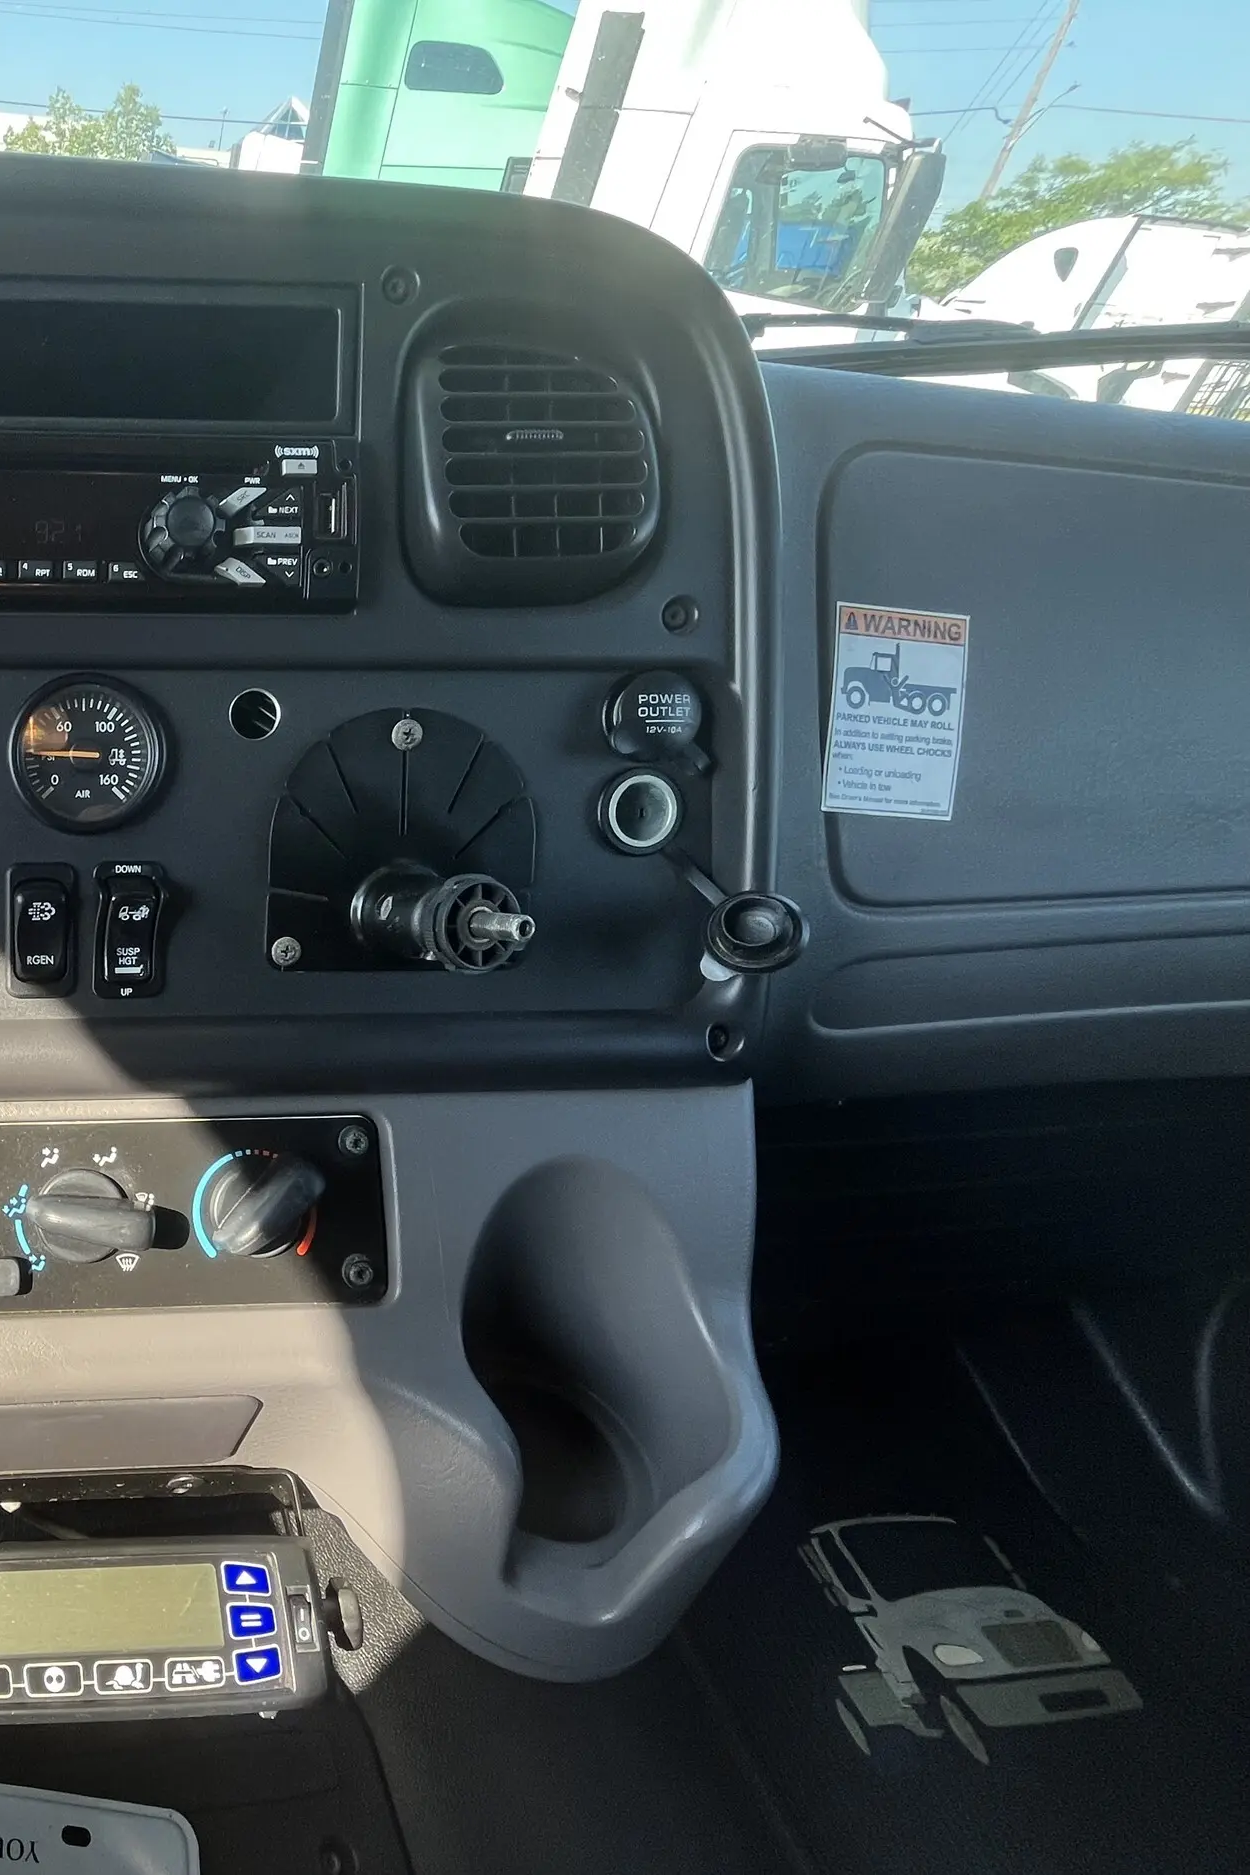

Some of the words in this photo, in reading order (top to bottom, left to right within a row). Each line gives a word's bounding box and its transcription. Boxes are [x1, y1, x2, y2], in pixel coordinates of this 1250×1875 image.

[160, 475, 182, 483] MENU
[188, 475, 199, 483] OK
[244, 477, 261, 485] PWR
[279, 506, 299, 514] NEXT
[256, 531, 277, 539] SCAN
[277, 557, 298, 566] PREV
[35, 568, 51, 577] RPT
[76, 568, 96, 577] RDM
[122, 570, 139, 579] ESC
[235, 566, 251, 580] DISP
[863, 612, 962, 642] WARNING
[638, 693, 691, 705] POWER
[637, 706, 691, 718] OUTLET
[836, 712, 871, 724] PARKED
[872, 715, 908, 727] VEHICLE
[910, 719, 929, 729] MAY
[56, 721, 72, 732] 60
[94, 721, 115, 733] 100
[645, 725, 683, 734] 12V-10A
[833, 739, 867, 751] ALWAYS
[868, 743, 885, 752] USE
[886, 745, 915, 755] WHEEL
[917, 747, 952, 758] CHOCKS
[843, 766, 873, 779] Loading
[874, 769, 883, 778] or
[884, 769, 922, 783] unloading
[98, 774, 119, 786] 160
[842, 779, 868, 791] Vehicle
[75, 789, 91, 798] AIR
[114, 864, 142, 874] DOWN
[116, 947, 141, 957] SUSP
[26, 955, 54, 966] RGEN
[118, 957, 138, 965] HGT
[120, 987, 133, 997] UP
